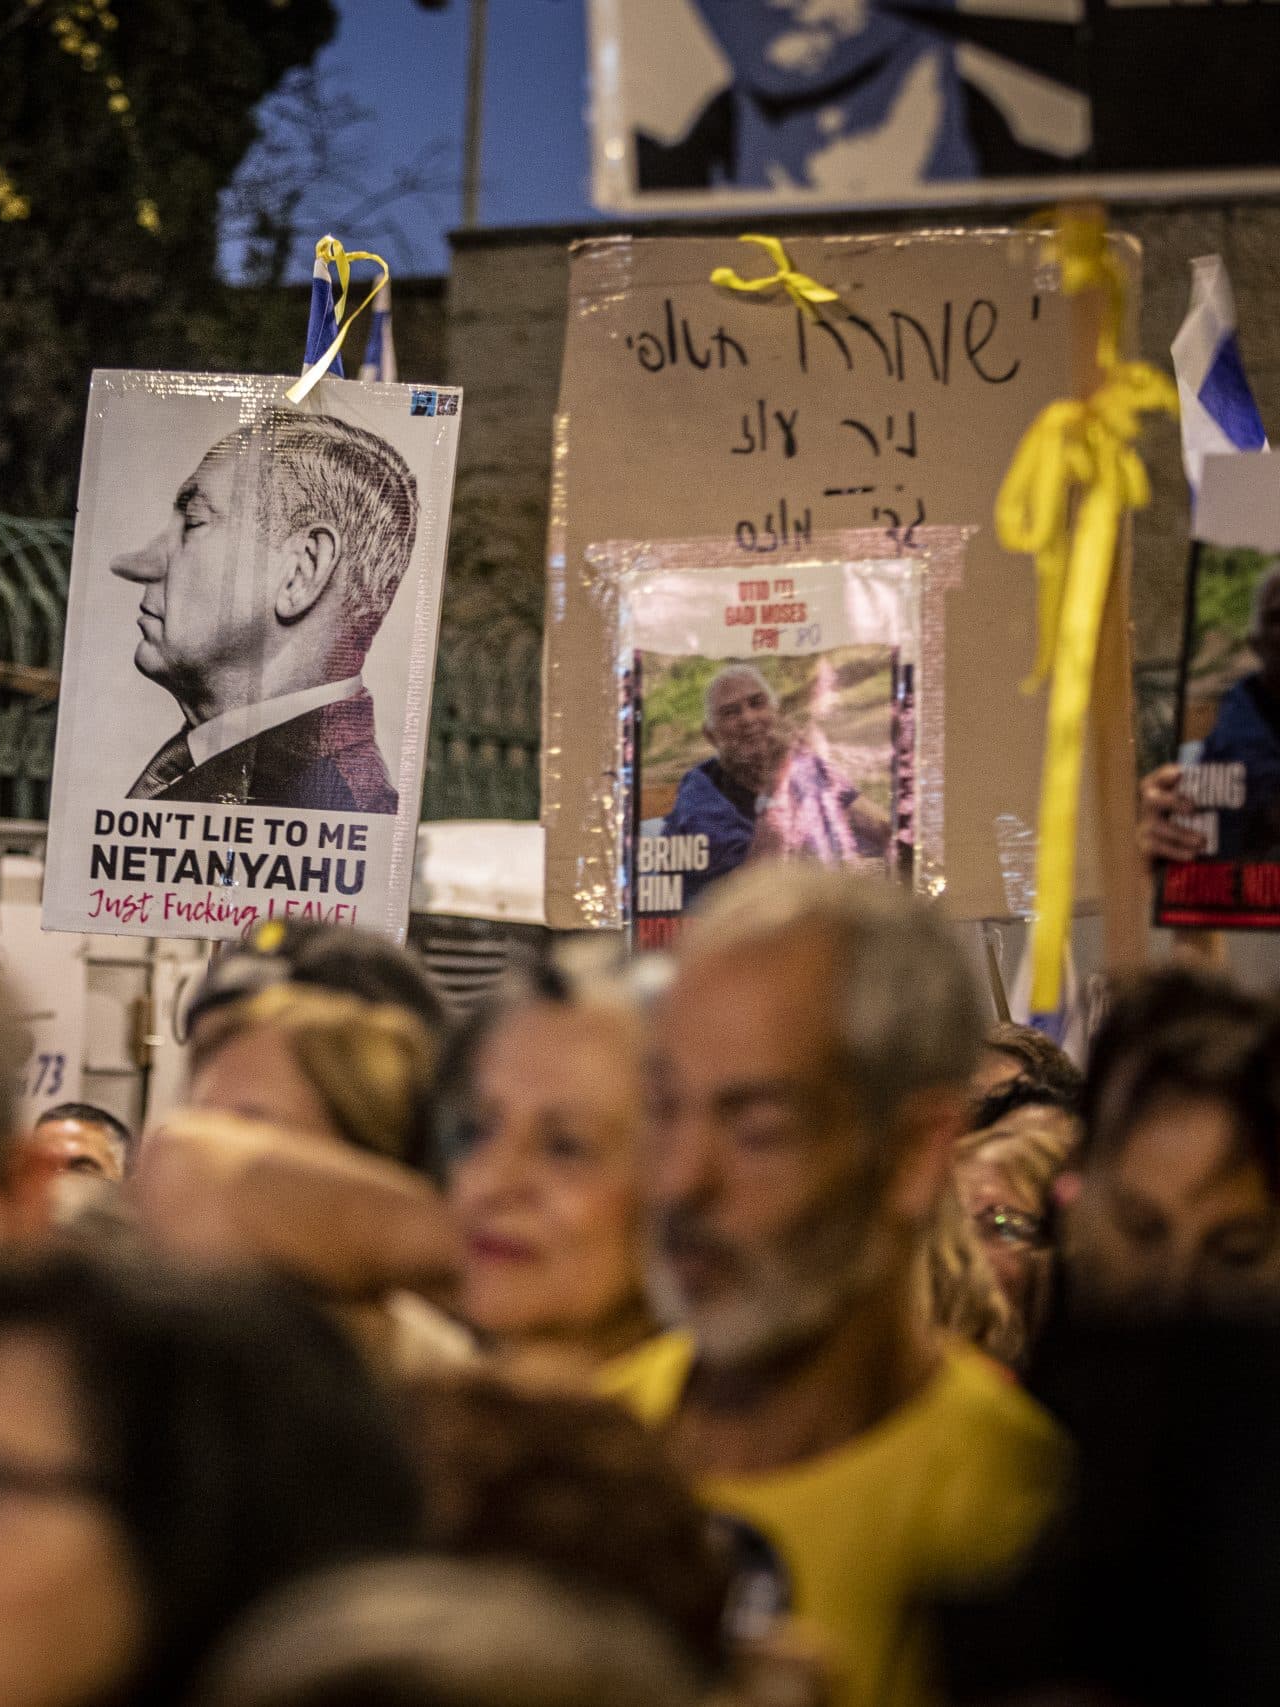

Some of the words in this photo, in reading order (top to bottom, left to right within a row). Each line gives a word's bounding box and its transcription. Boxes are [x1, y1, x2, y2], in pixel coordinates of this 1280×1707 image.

[731, 400, 798, 458] עוז
[840, 411, 918, 458] ניר
[94, 809, 195, 840] DON'T
[202, 815, 255, 844] LIE
[264, 819, 308, 847] TO
[318, 822, 369, 851] ME
[637, 833, 710, 872] BRING
[90, 844, 367, 895] NETANYAHU
[637, 874, 684, 912] HIM
[88, 889, 154, 924] Just
[163, 891, 260, 940] Fucking
